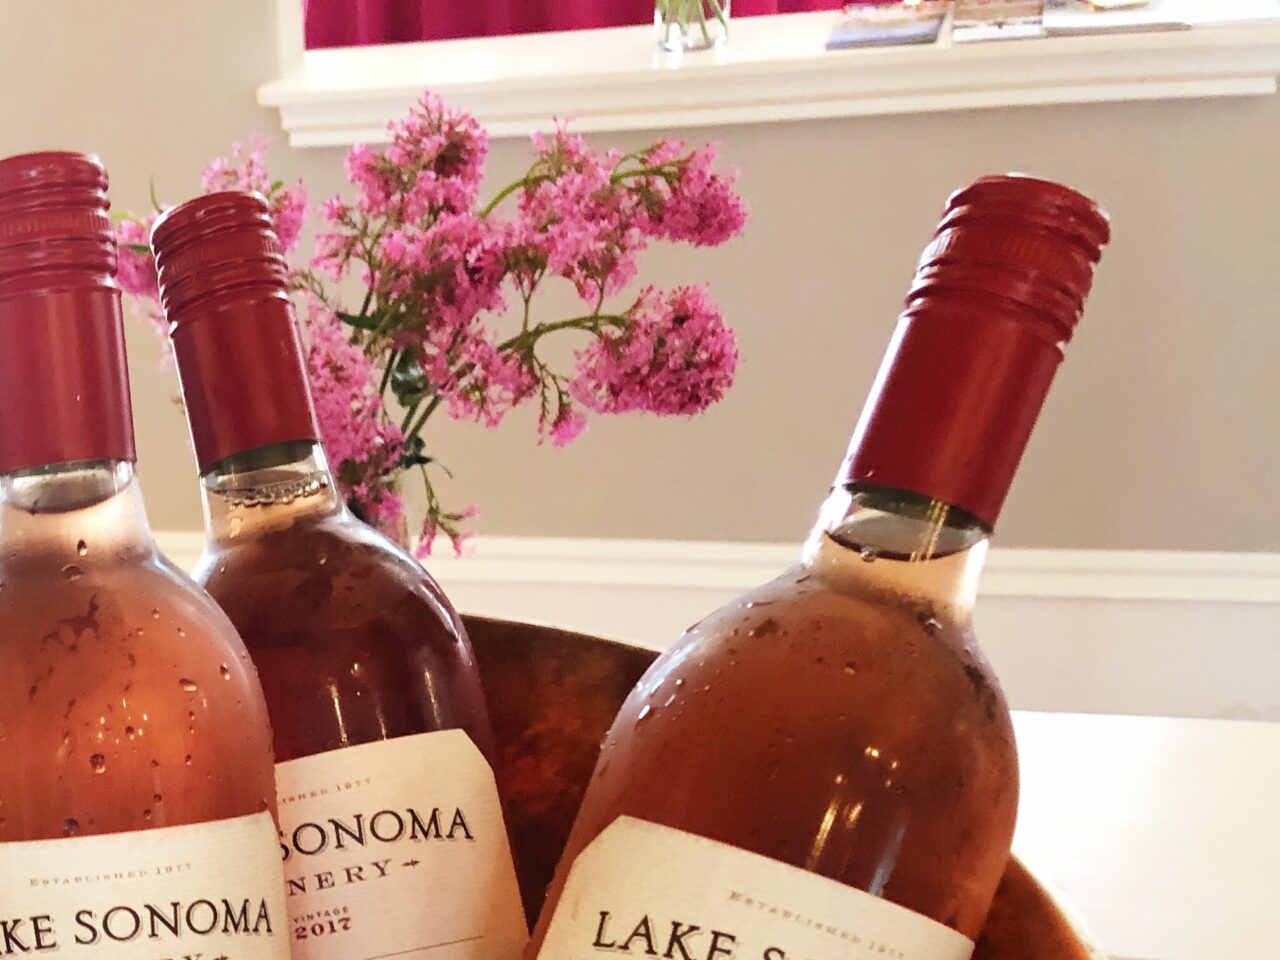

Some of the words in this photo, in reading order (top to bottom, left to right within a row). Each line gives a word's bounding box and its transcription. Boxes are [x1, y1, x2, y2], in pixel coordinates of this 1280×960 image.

[287, 859, 391, 896] NERY
[74, 897, 273, 944] SONOMA
[295, 917, 351, 940] 2017
